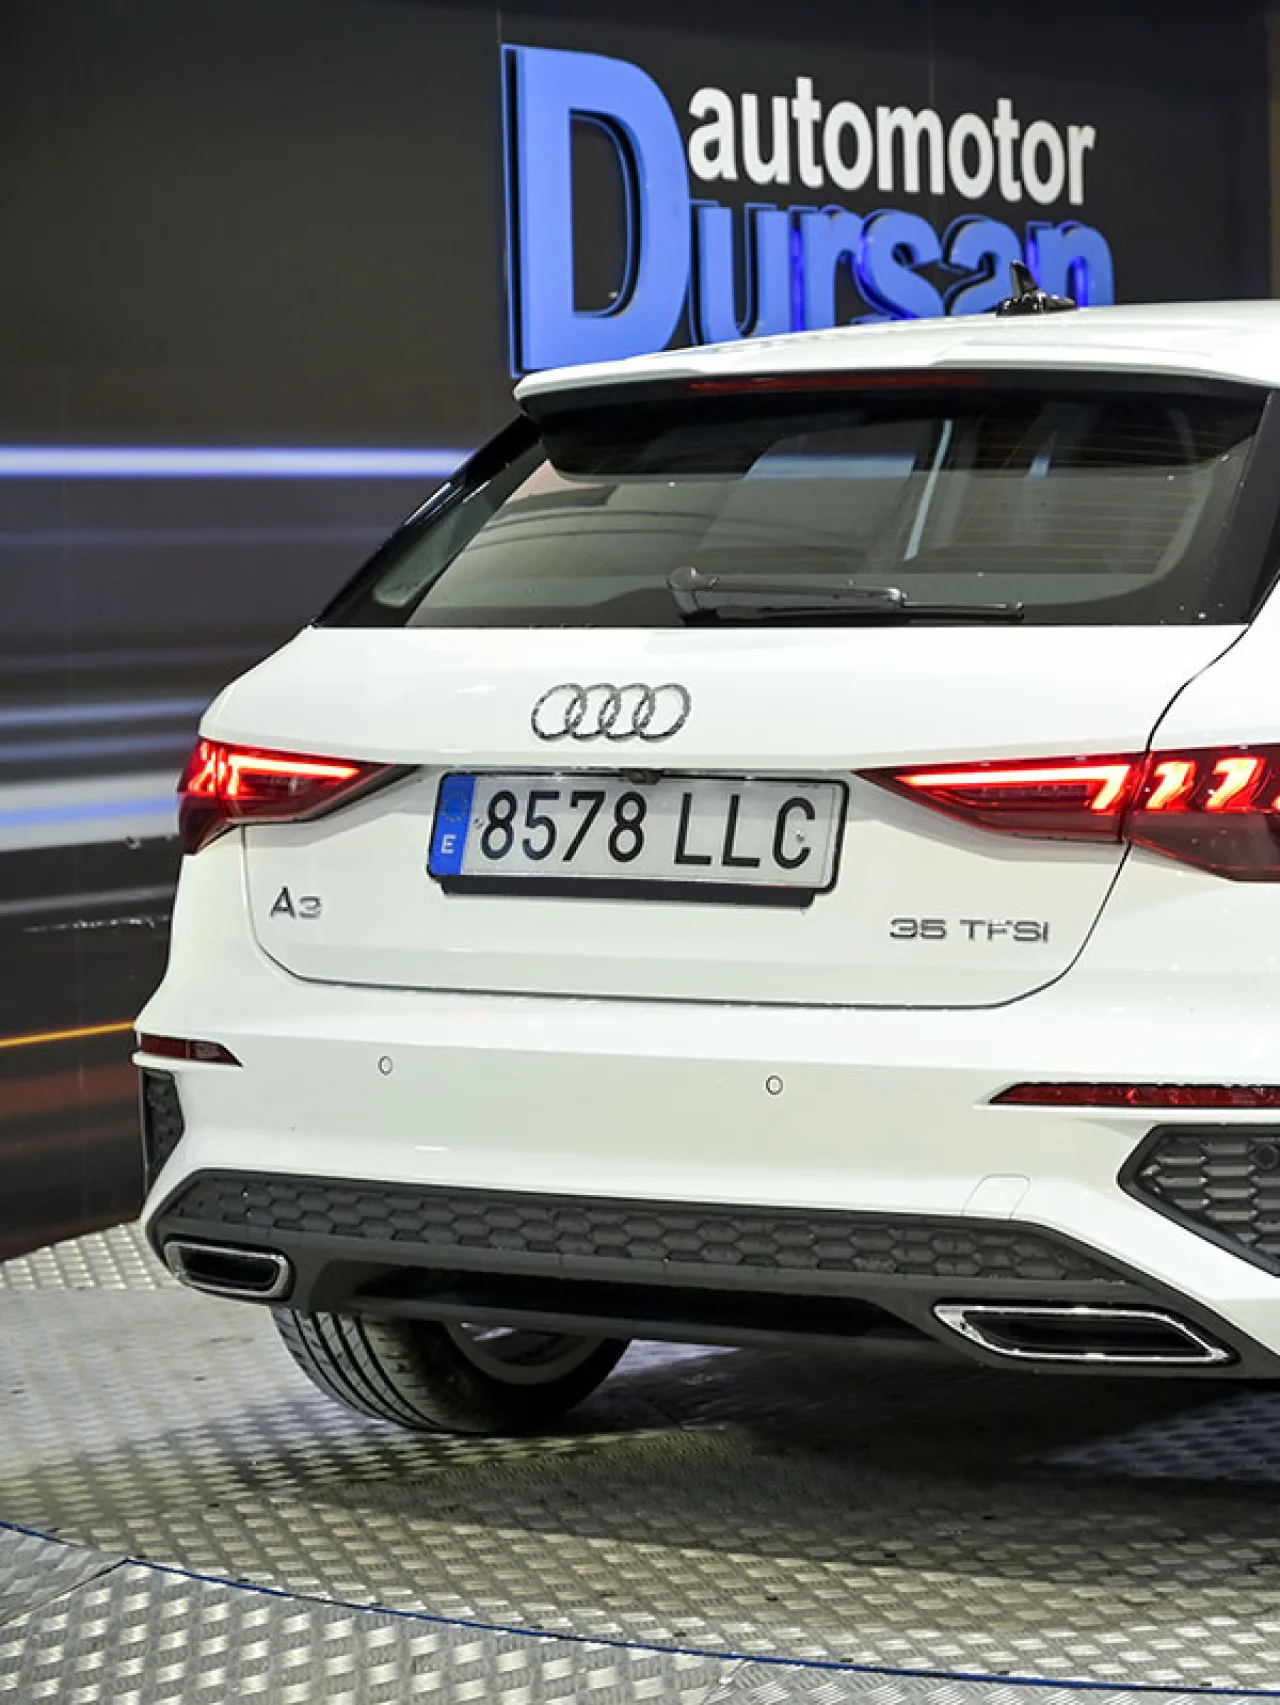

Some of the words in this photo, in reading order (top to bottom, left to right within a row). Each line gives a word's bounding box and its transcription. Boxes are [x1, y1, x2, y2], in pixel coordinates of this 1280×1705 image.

[688, 76, 1096, 205] automotor
[502, 44, 1114, 378] Dursan
[440, 834, 457, 854] E
[480, 789, 648, 863] 8578
[673, 792, 817, 870] LLC
[269, 885, 322, 920] A3
[889, 917, 947, 941] 35
[959, 918, 1050, 943] TFSI
